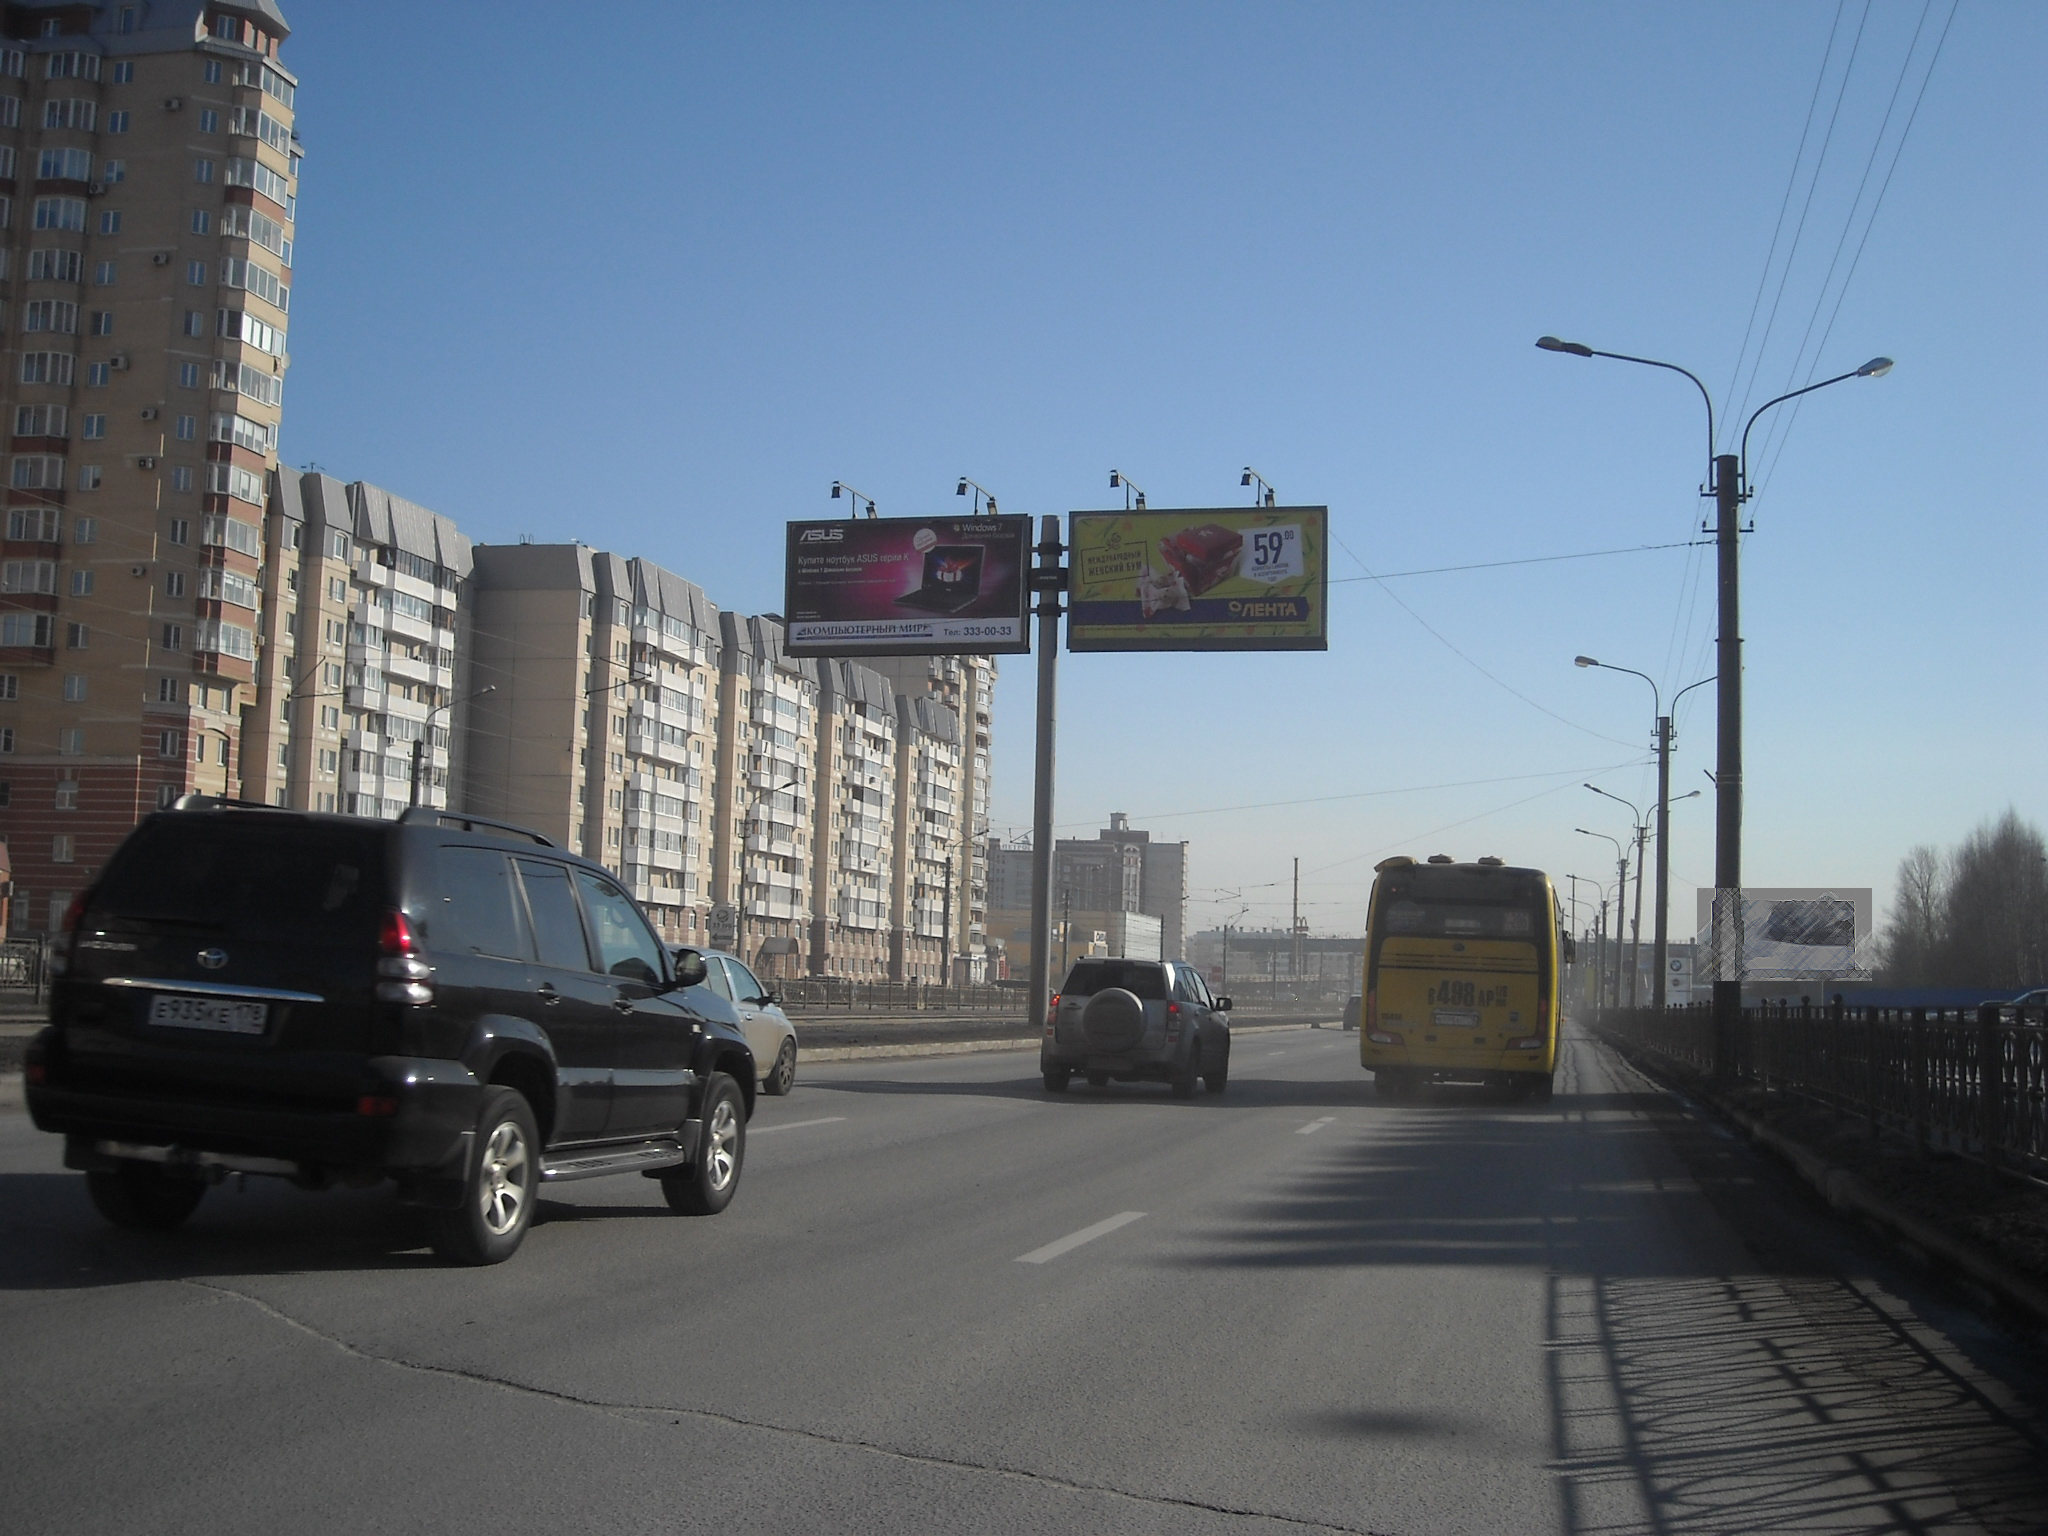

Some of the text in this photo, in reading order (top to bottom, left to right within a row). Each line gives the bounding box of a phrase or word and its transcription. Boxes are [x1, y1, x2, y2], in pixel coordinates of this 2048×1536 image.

[962, 523, 997, 532] Windows
[799, 529, 844, 541] ASUS
[1254, 530, 1295, 566] 59 00
[798, 556, 825, 567] Купите
[826, 554, 855, 566] ноутбук
[856, 553, 879, 563] ASUS
[1088, 561, 1142, 577] ЖЕНСКИЙ БУМ
[1242, 602, 1297, 617] ЛЕНТА
[806, 624, 896, 635] КОМПЬЮТЕРНЫЙ
[944, 628, 961, 636] Тел:
[963, 626, 1012, 636] 333-00-33
[1437, 979, 1476, 1008] 498
